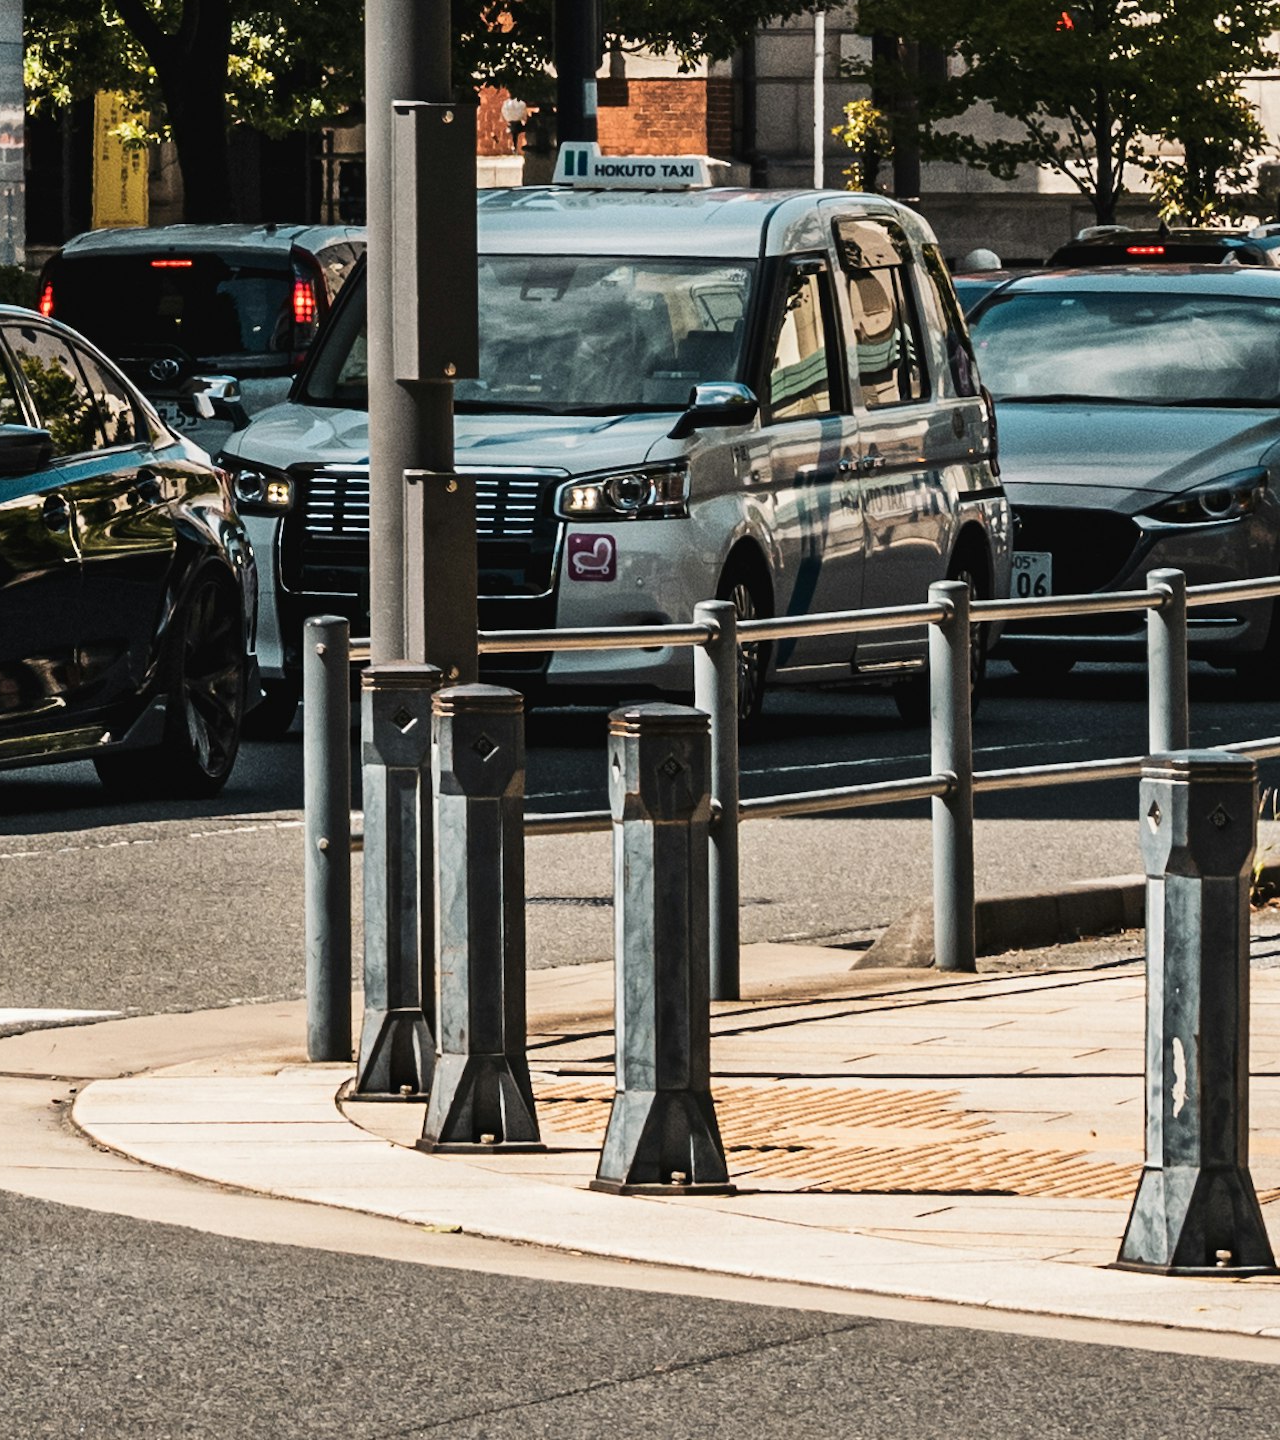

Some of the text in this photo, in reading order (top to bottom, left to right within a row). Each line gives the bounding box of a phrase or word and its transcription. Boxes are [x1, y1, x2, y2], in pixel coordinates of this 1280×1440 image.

[594, 164, 694, 178] HOKUTO TAXI
[1012, 555, 1030, 570] 05
